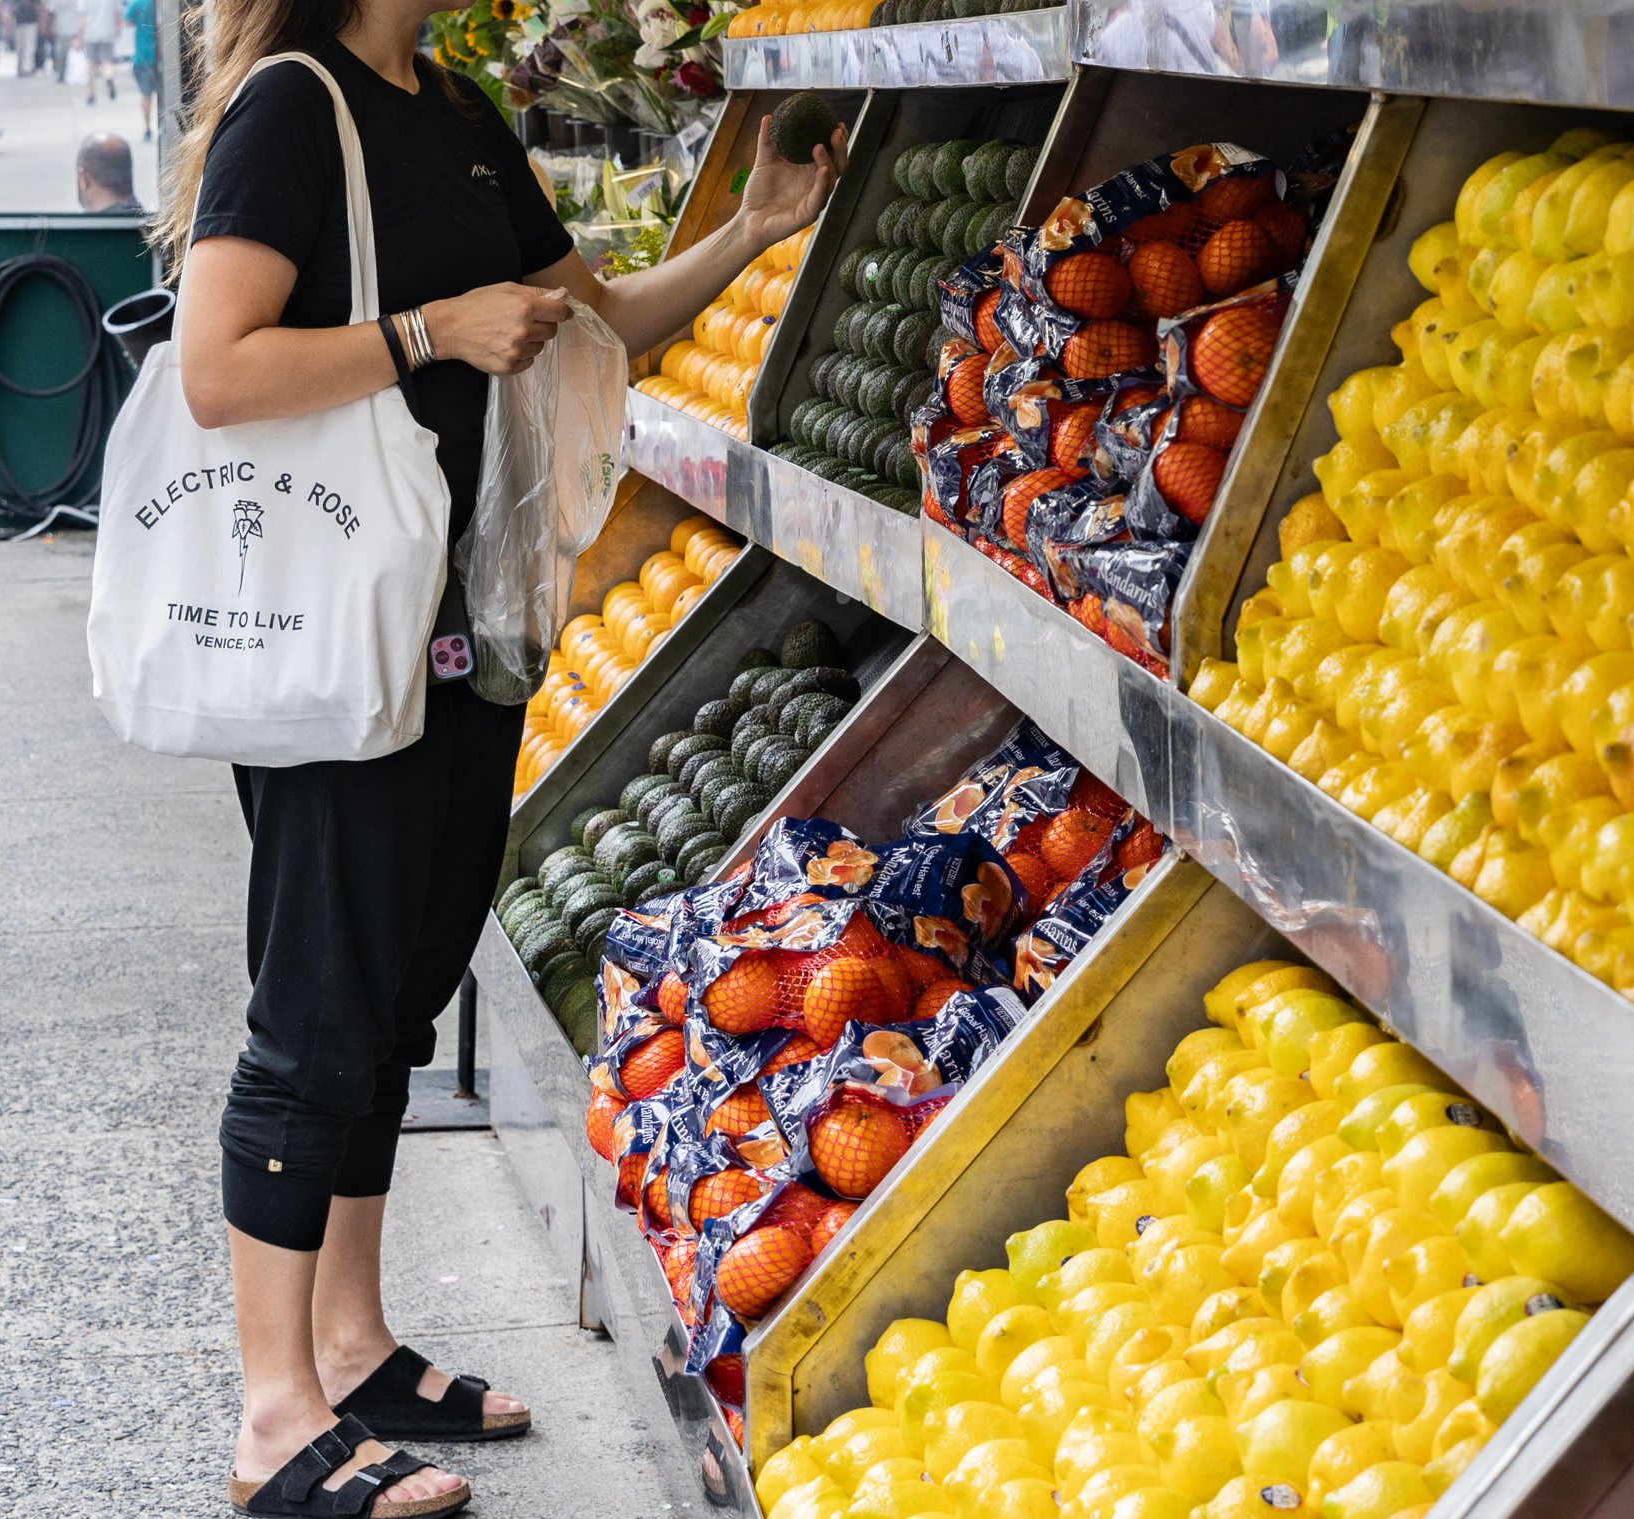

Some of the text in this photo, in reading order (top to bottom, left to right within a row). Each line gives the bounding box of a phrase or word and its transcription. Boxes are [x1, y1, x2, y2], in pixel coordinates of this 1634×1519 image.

[134, 461, 361, 541] ELECTRIC & ROSE
[166, 602, 305, 632] TIME TO LIVE
[194, 633, 265, 651] VENICE, CA
